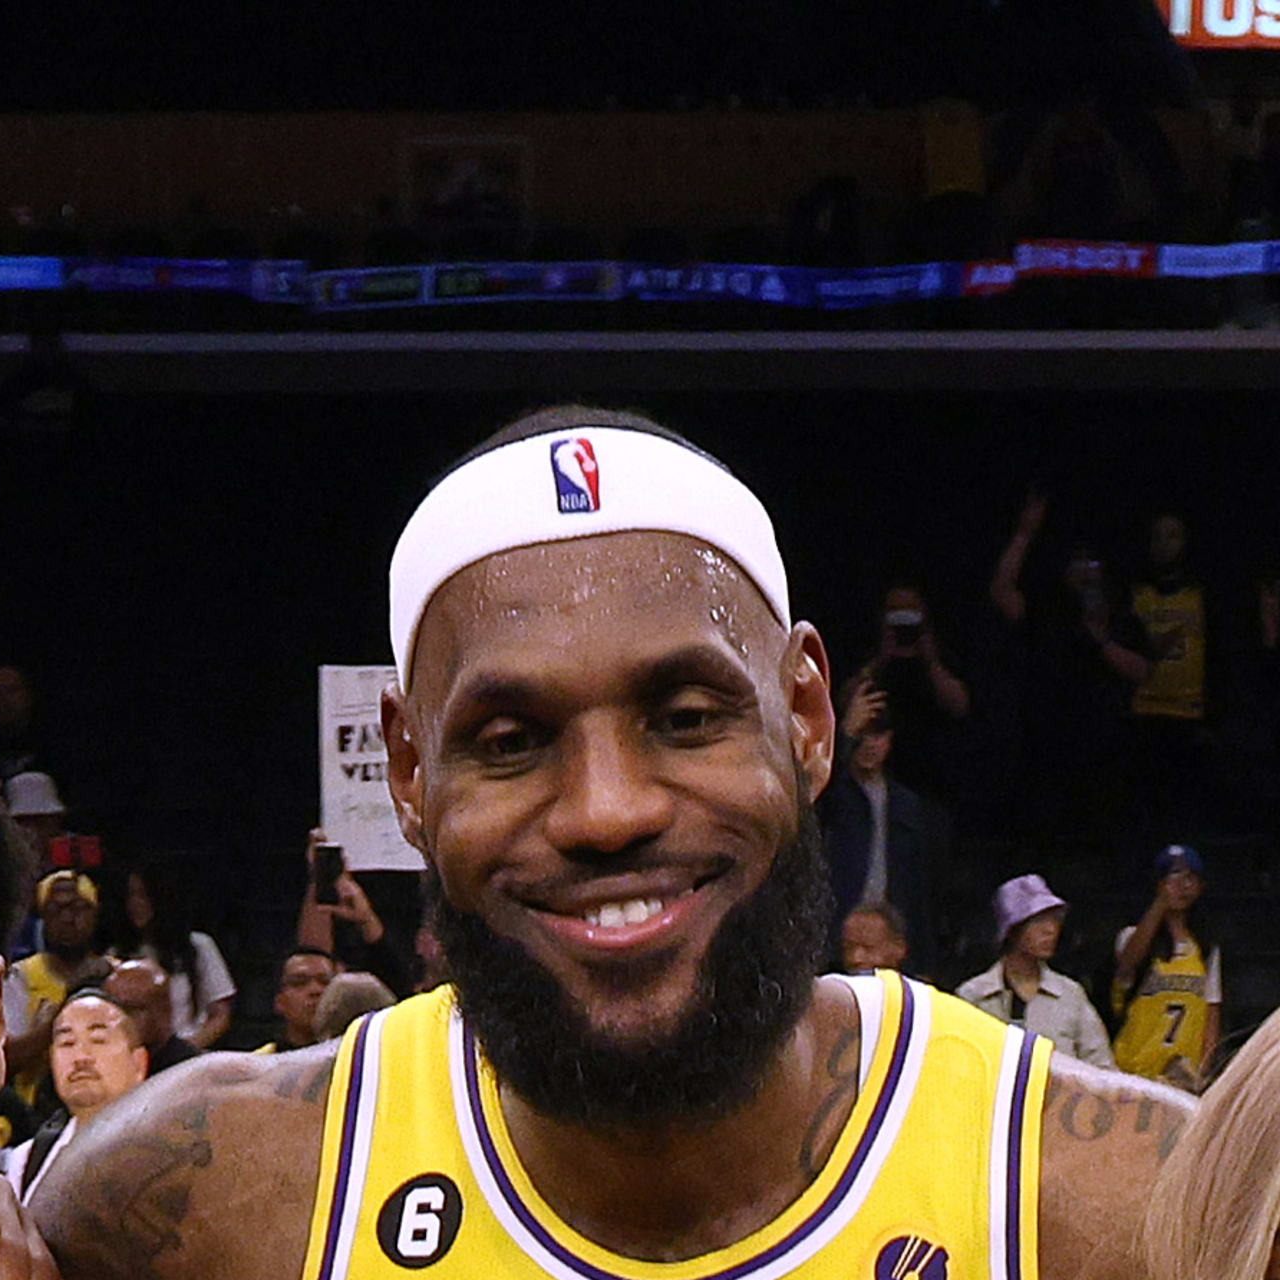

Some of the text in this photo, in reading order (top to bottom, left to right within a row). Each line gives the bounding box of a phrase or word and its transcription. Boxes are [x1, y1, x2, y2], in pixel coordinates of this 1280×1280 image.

[561, 493, 588, 510] NBA
[1162, 1001, 1187, 1046] 7
[396, 1185, 446, 1258] 6
